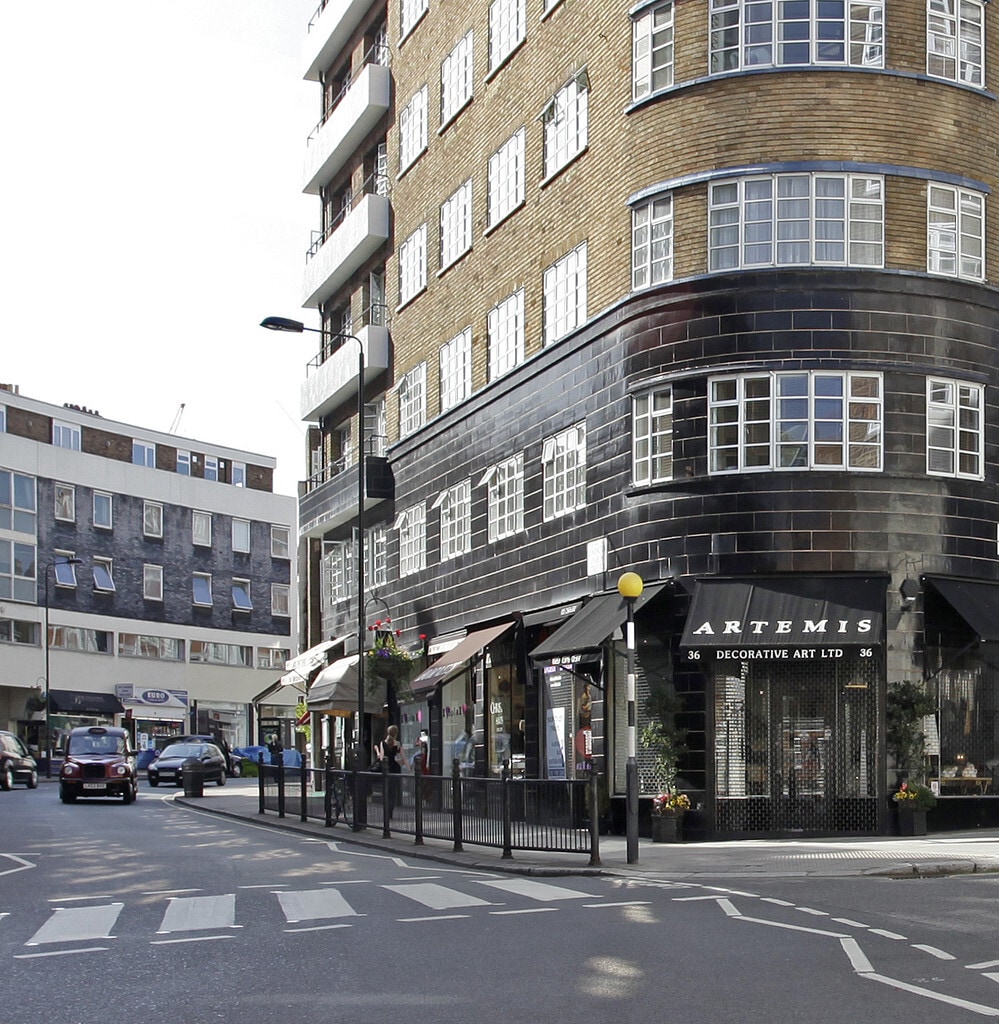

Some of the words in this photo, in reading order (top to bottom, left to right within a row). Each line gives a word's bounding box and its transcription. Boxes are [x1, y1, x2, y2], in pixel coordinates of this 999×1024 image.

[693, 619, 872, 635] ARTEMIS
[688, 650, 701, 660] 36
[716, 649, 789, 660] DECORATIVE
[793, 649, 816, 658] ART
[821, 648, 843, 658] LTD
[859, 647, 873, 657] 36
[147, 691, 166, 699] EURO
